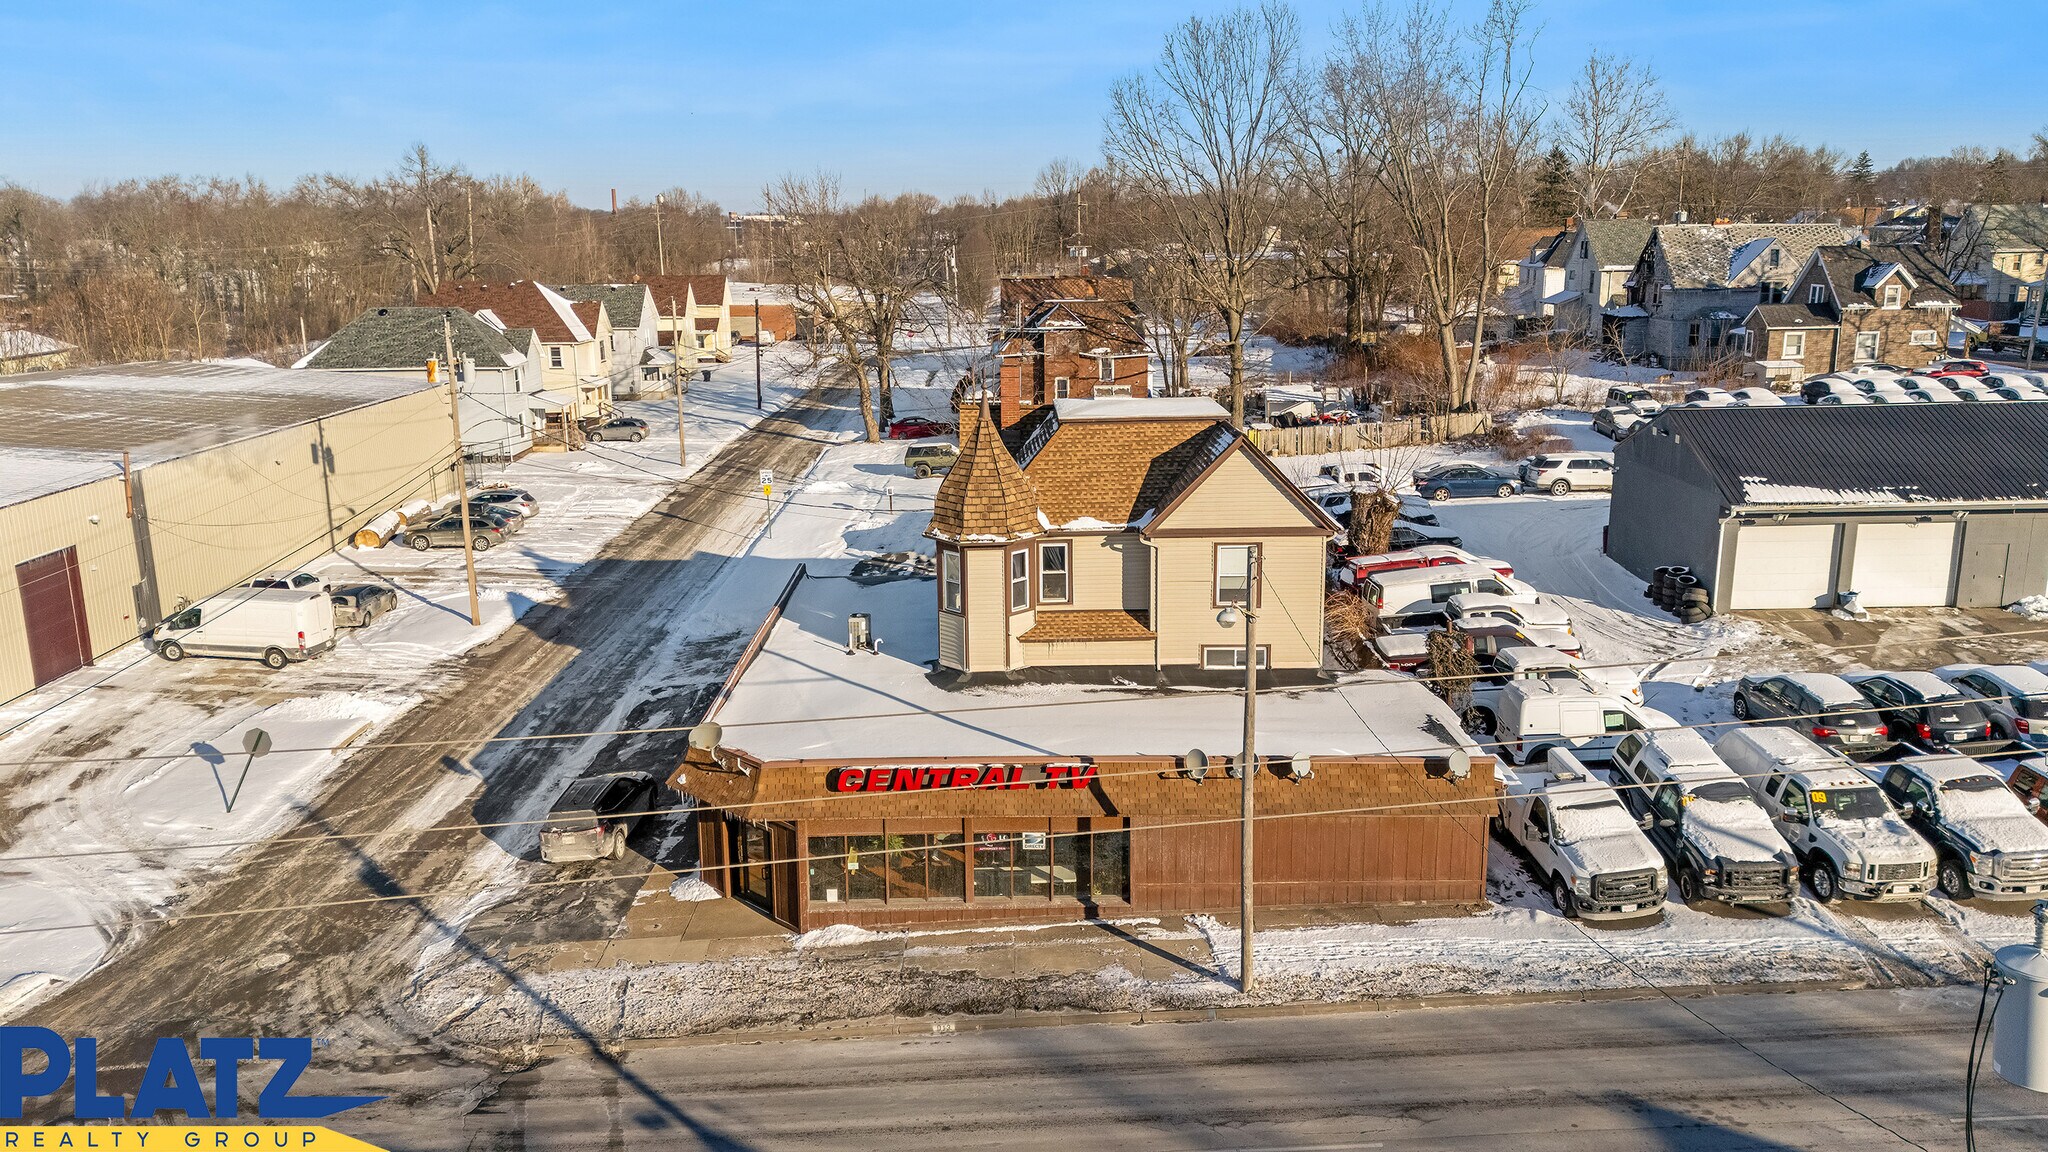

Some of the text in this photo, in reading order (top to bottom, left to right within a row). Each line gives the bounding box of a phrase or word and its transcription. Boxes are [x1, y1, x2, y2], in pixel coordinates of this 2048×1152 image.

[837, 766, 1099, 792] CENTRAL TV
[1811, 791, 1827, 803] 09
